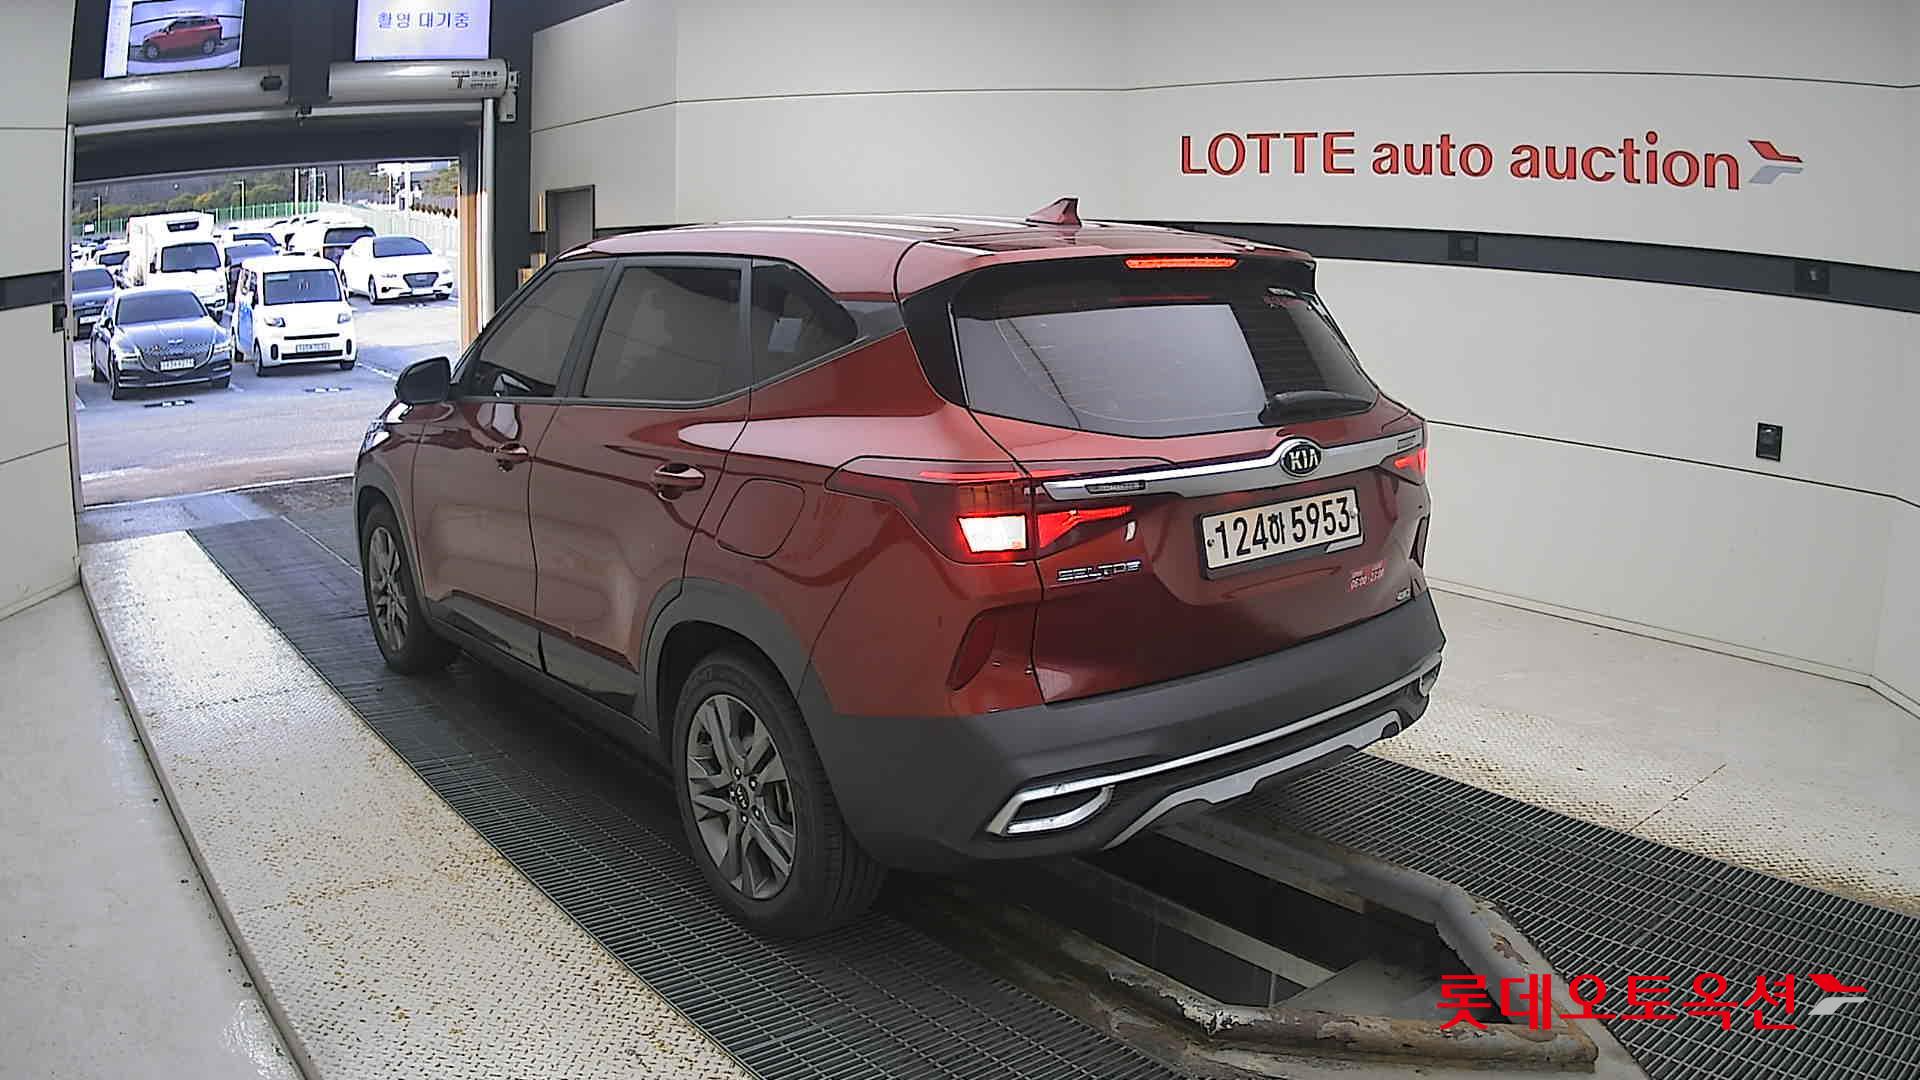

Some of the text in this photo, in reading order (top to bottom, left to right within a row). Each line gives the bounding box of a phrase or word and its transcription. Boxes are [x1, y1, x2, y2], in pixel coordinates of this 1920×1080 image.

[418, 11, 471, 29] 대기중
[1180, 130, 1741, 190] LOTTE auto auction
[1289, 448, 1319, 471] KIA
[1291, 496, 1351, 543] 5953
[1057, 560, 1141, 582] SELTOS
